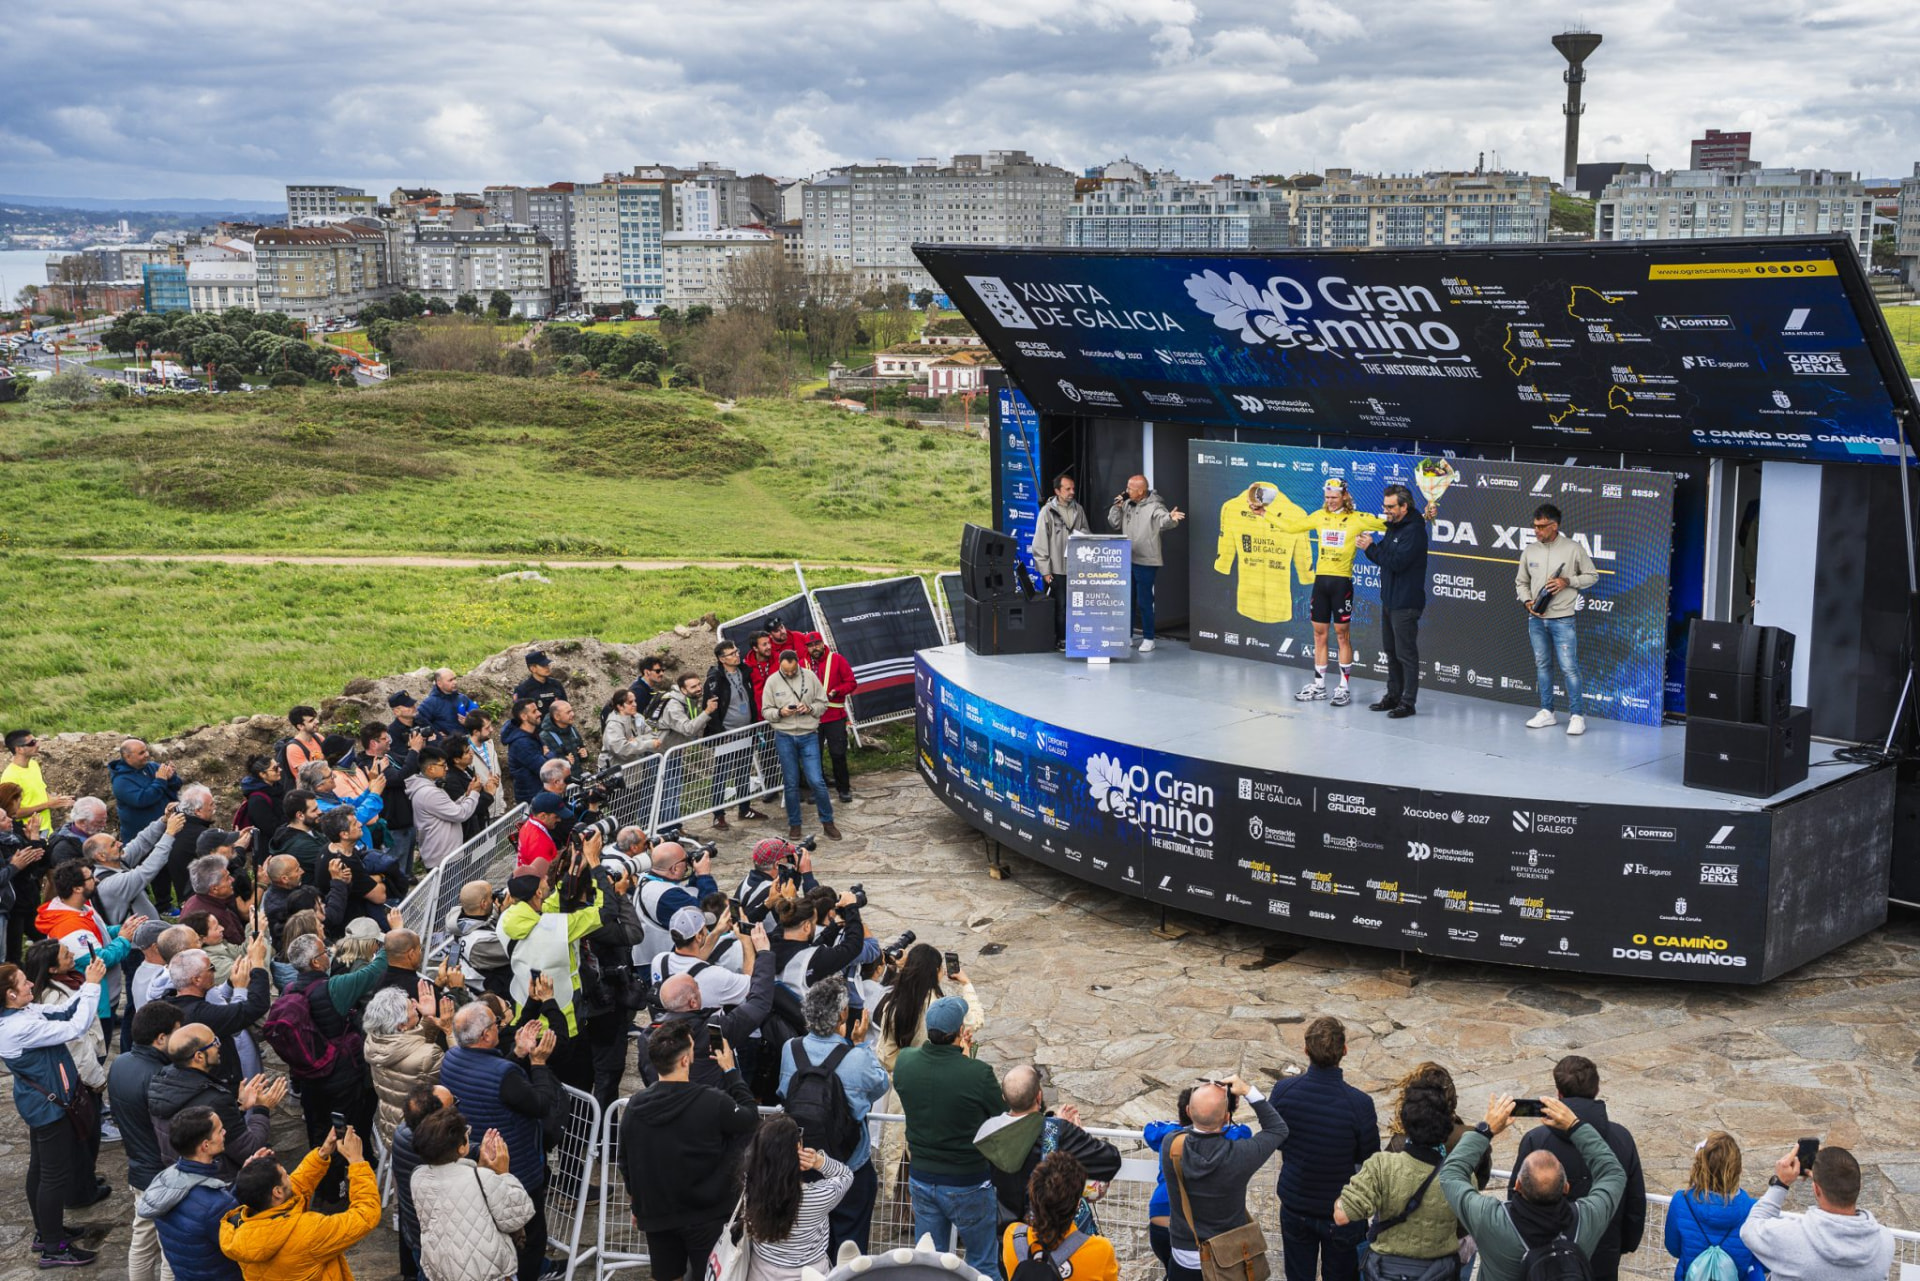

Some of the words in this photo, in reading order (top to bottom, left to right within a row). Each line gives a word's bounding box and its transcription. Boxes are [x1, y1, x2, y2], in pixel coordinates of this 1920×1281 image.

[1013, 282, 1111, 305] XUNTA
[1267, 276, 1313, 311] O
[1317, 276, 1442, 313] Gran
[1031, 307, 1072, 327] DE
[1073, 308, 1185, 332] GALICIA
[1678, 318, 1729, 327] CORTIZO
[1787, 354, 1831, 364] CABO
[1361, 363, 1385, 375] THE
[1384, 364, 1445, 378] HISTORICAL
[1443, 366, 1482, 379] ROUTE
[1717, 361, 1750, 370] seguros
[1792, 362, 1847, 373] PEÑAS
[1692, 429, 1705, 437] O
[1709, 430, 1772, 440] CAMIÑO
[1775, 432, 1813, 441] DOS
[1816, 433, 1898, 445] CAMIÑOS
[1489, 478, 1519, 487] CORTIZO
[1253, 538, 1275, 546] XUNTA
[1492, 524, 1616, 560] XEAL
[1102, 546, 1122, 555] Gran
[1262, 546, 1287, 555] GALICIA
[1433, 573, 1474, 588] GALICIA
[1433, 585, 1486, 602] CALIDADE
[1588, 598, 1614, 612] 2027
[1048, 736, 1069, 748] DEPORTE
[1128, 765, 1149, 793] O
[1154, 771, 1214, 808] Gran
[1254, 782, 1284, 795] XUNTA
[1254, 791, 1265, 801] DE
[1267, 793, 1302, 807] GALICIA
[1328, 793, 1365, 806] GALICIA
[1328, 803, 1377, 817] CALIDADE
[1403, 806, 1449, 821] Xacobeo
[1467, 814, 1490, 825] 2027
[1537, 814, 1578, 825] DEPORTE
[1265, 826, 1296, 838] Deputación
[1537, 824, 1574, 835] GALEGO
[1638, 829, 1674, 838] CORTIZO
[1151, 837, 1162, 848] THE
[1162, 840, 1194, 856] HISTORICAL
[1195, 848, 1214, 860] ROUTE
[1433, 847, 1474, 857] Deputación
[1433, 852, 1474, 863] Pontevedra
[1511, 865, 1555, 875] DEPUTACIÓN
[1648, 869, 1672, 877] seguros
[1701, 866, 1730, 875] CABO
[1516, 872, 1549, 881] OURENSE
[1701, 873, 1738, 884] PEÑAS
[1309, 910, 1330, 919] asisa
[1448, 928, 1479, 939] BYD
[1500, 934, 1525, 944] terxy
[1632, 934, 1647, 945] O
[1653, 935, 1728, 950] CAMIÑO
[1612, 947, 1653, 960] DOS
[1659, 952, 1748, 967] CAMIÑOS
